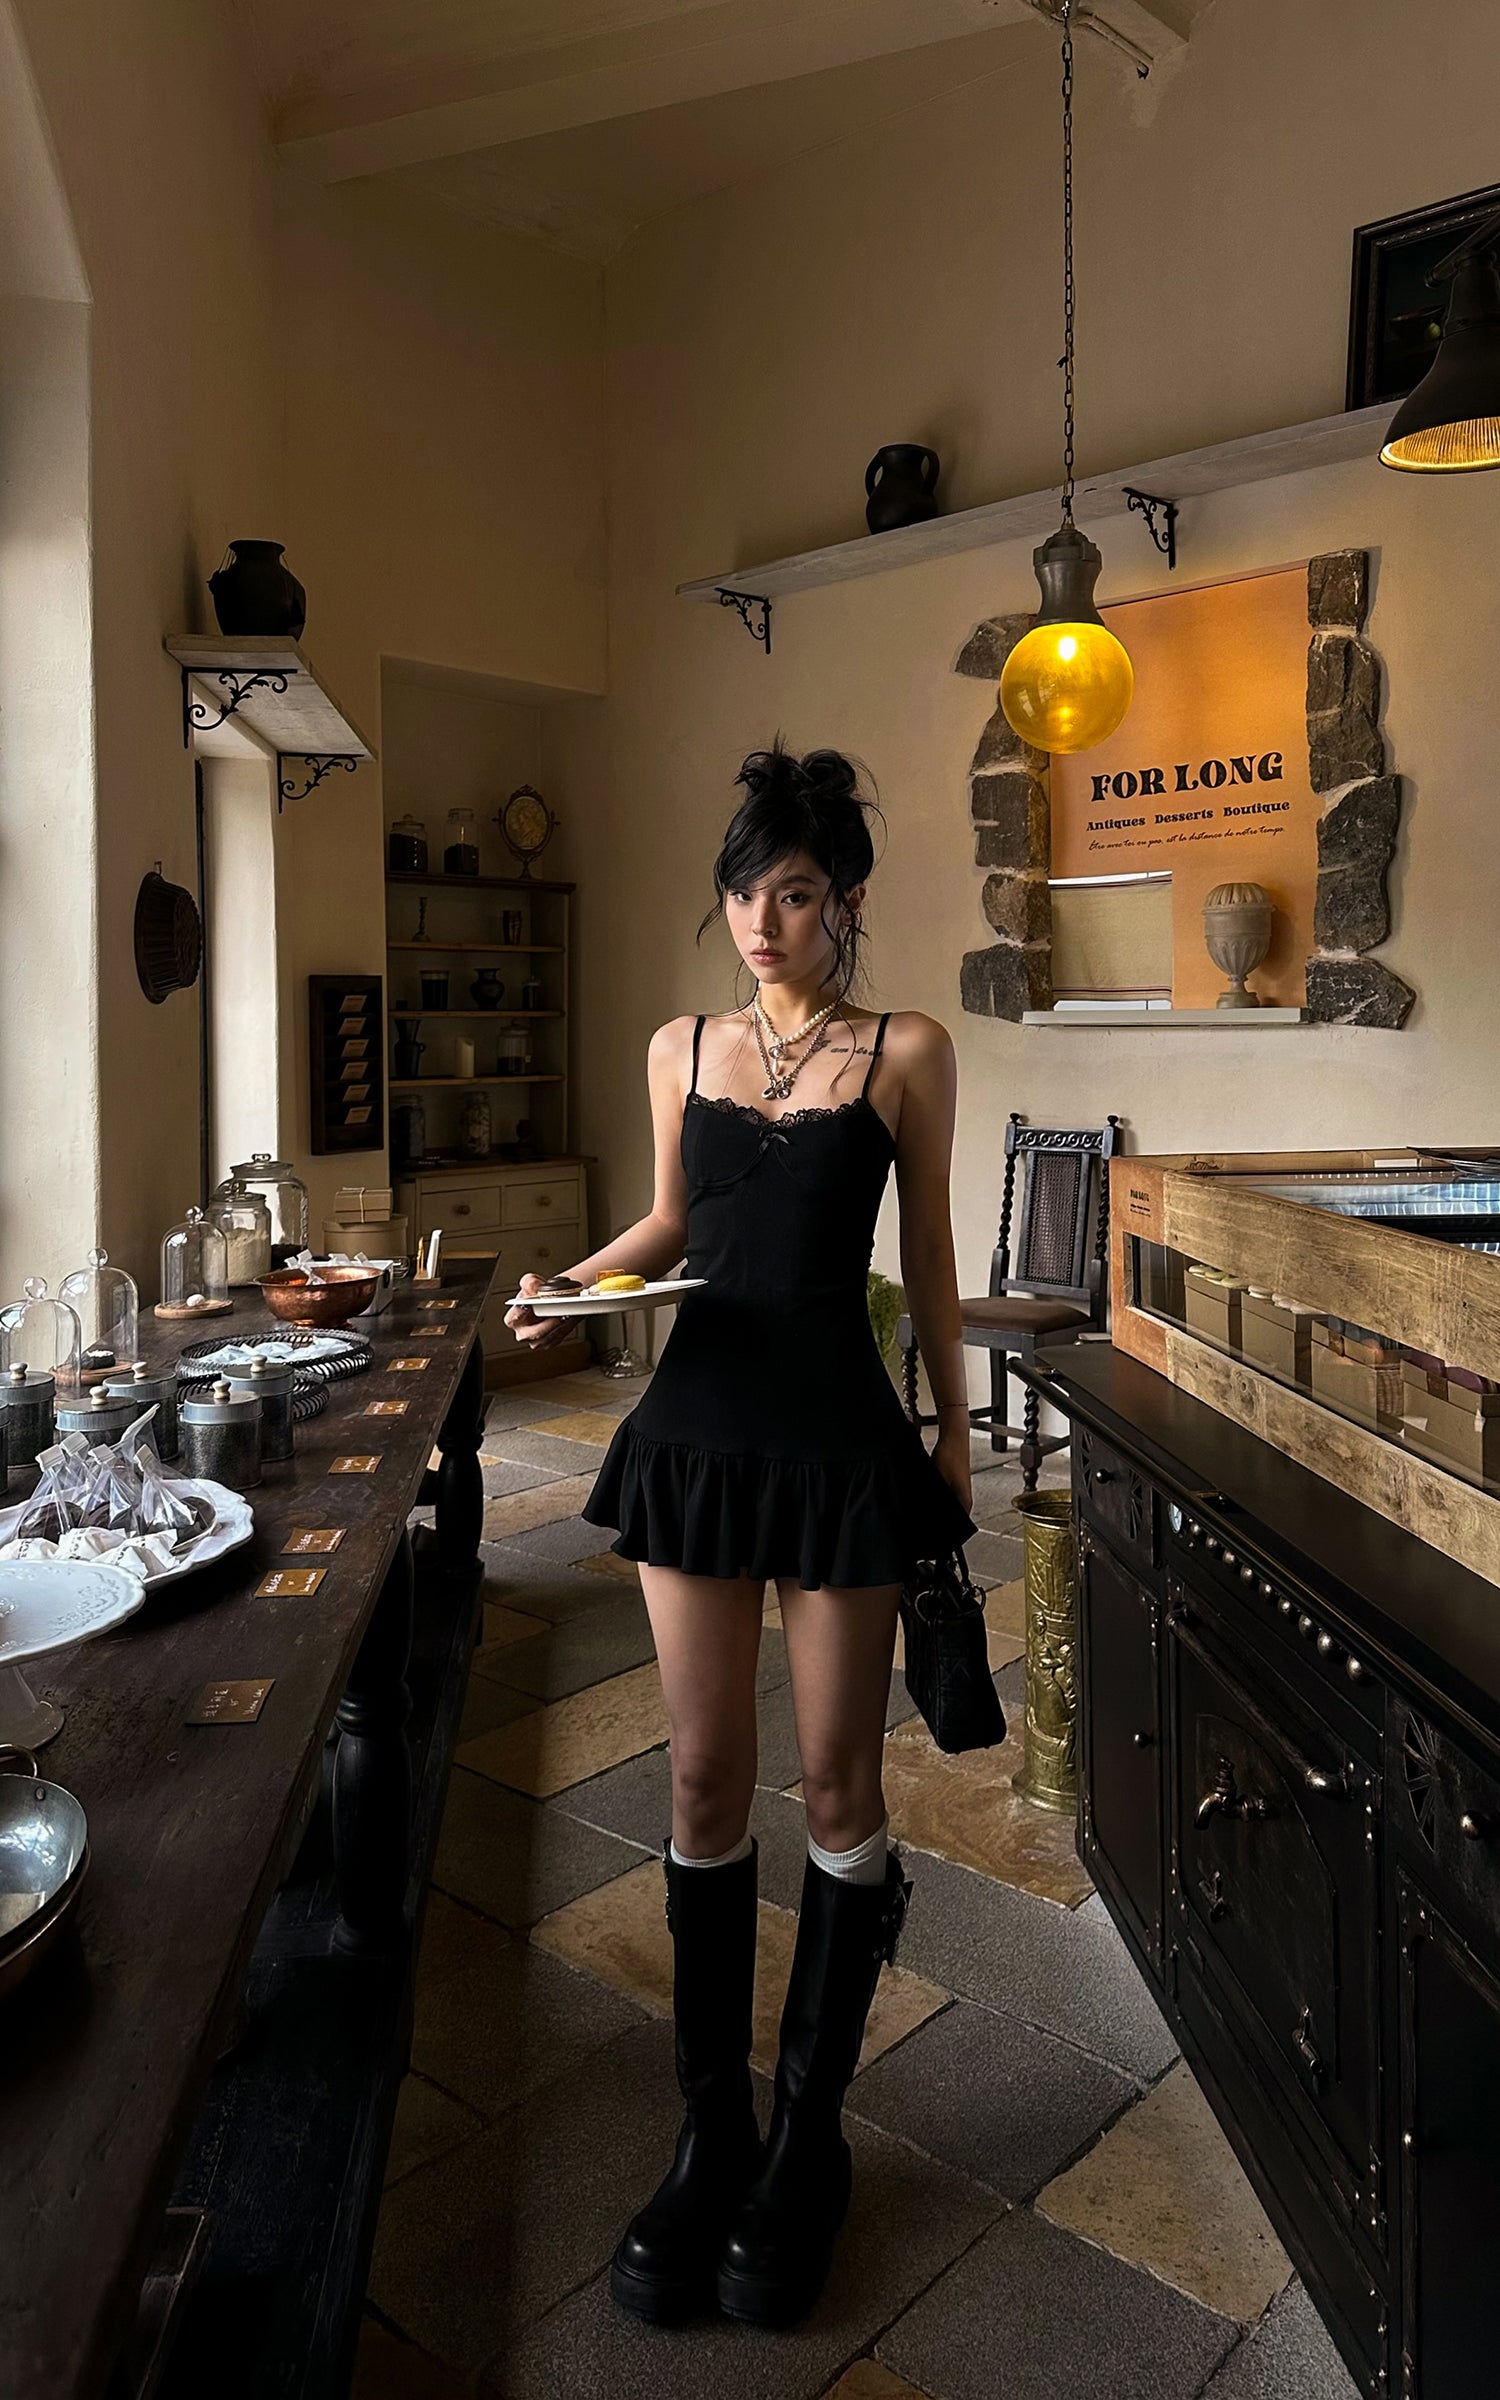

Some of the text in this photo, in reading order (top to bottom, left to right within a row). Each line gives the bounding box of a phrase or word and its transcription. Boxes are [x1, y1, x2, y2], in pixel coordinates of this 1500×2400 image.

[1091, 752, 1283, 802] FOR LONG
[1086, 801, 1290, 831] Antiques Desserts Boutique
[1188, 831, 1223, 841] distance
